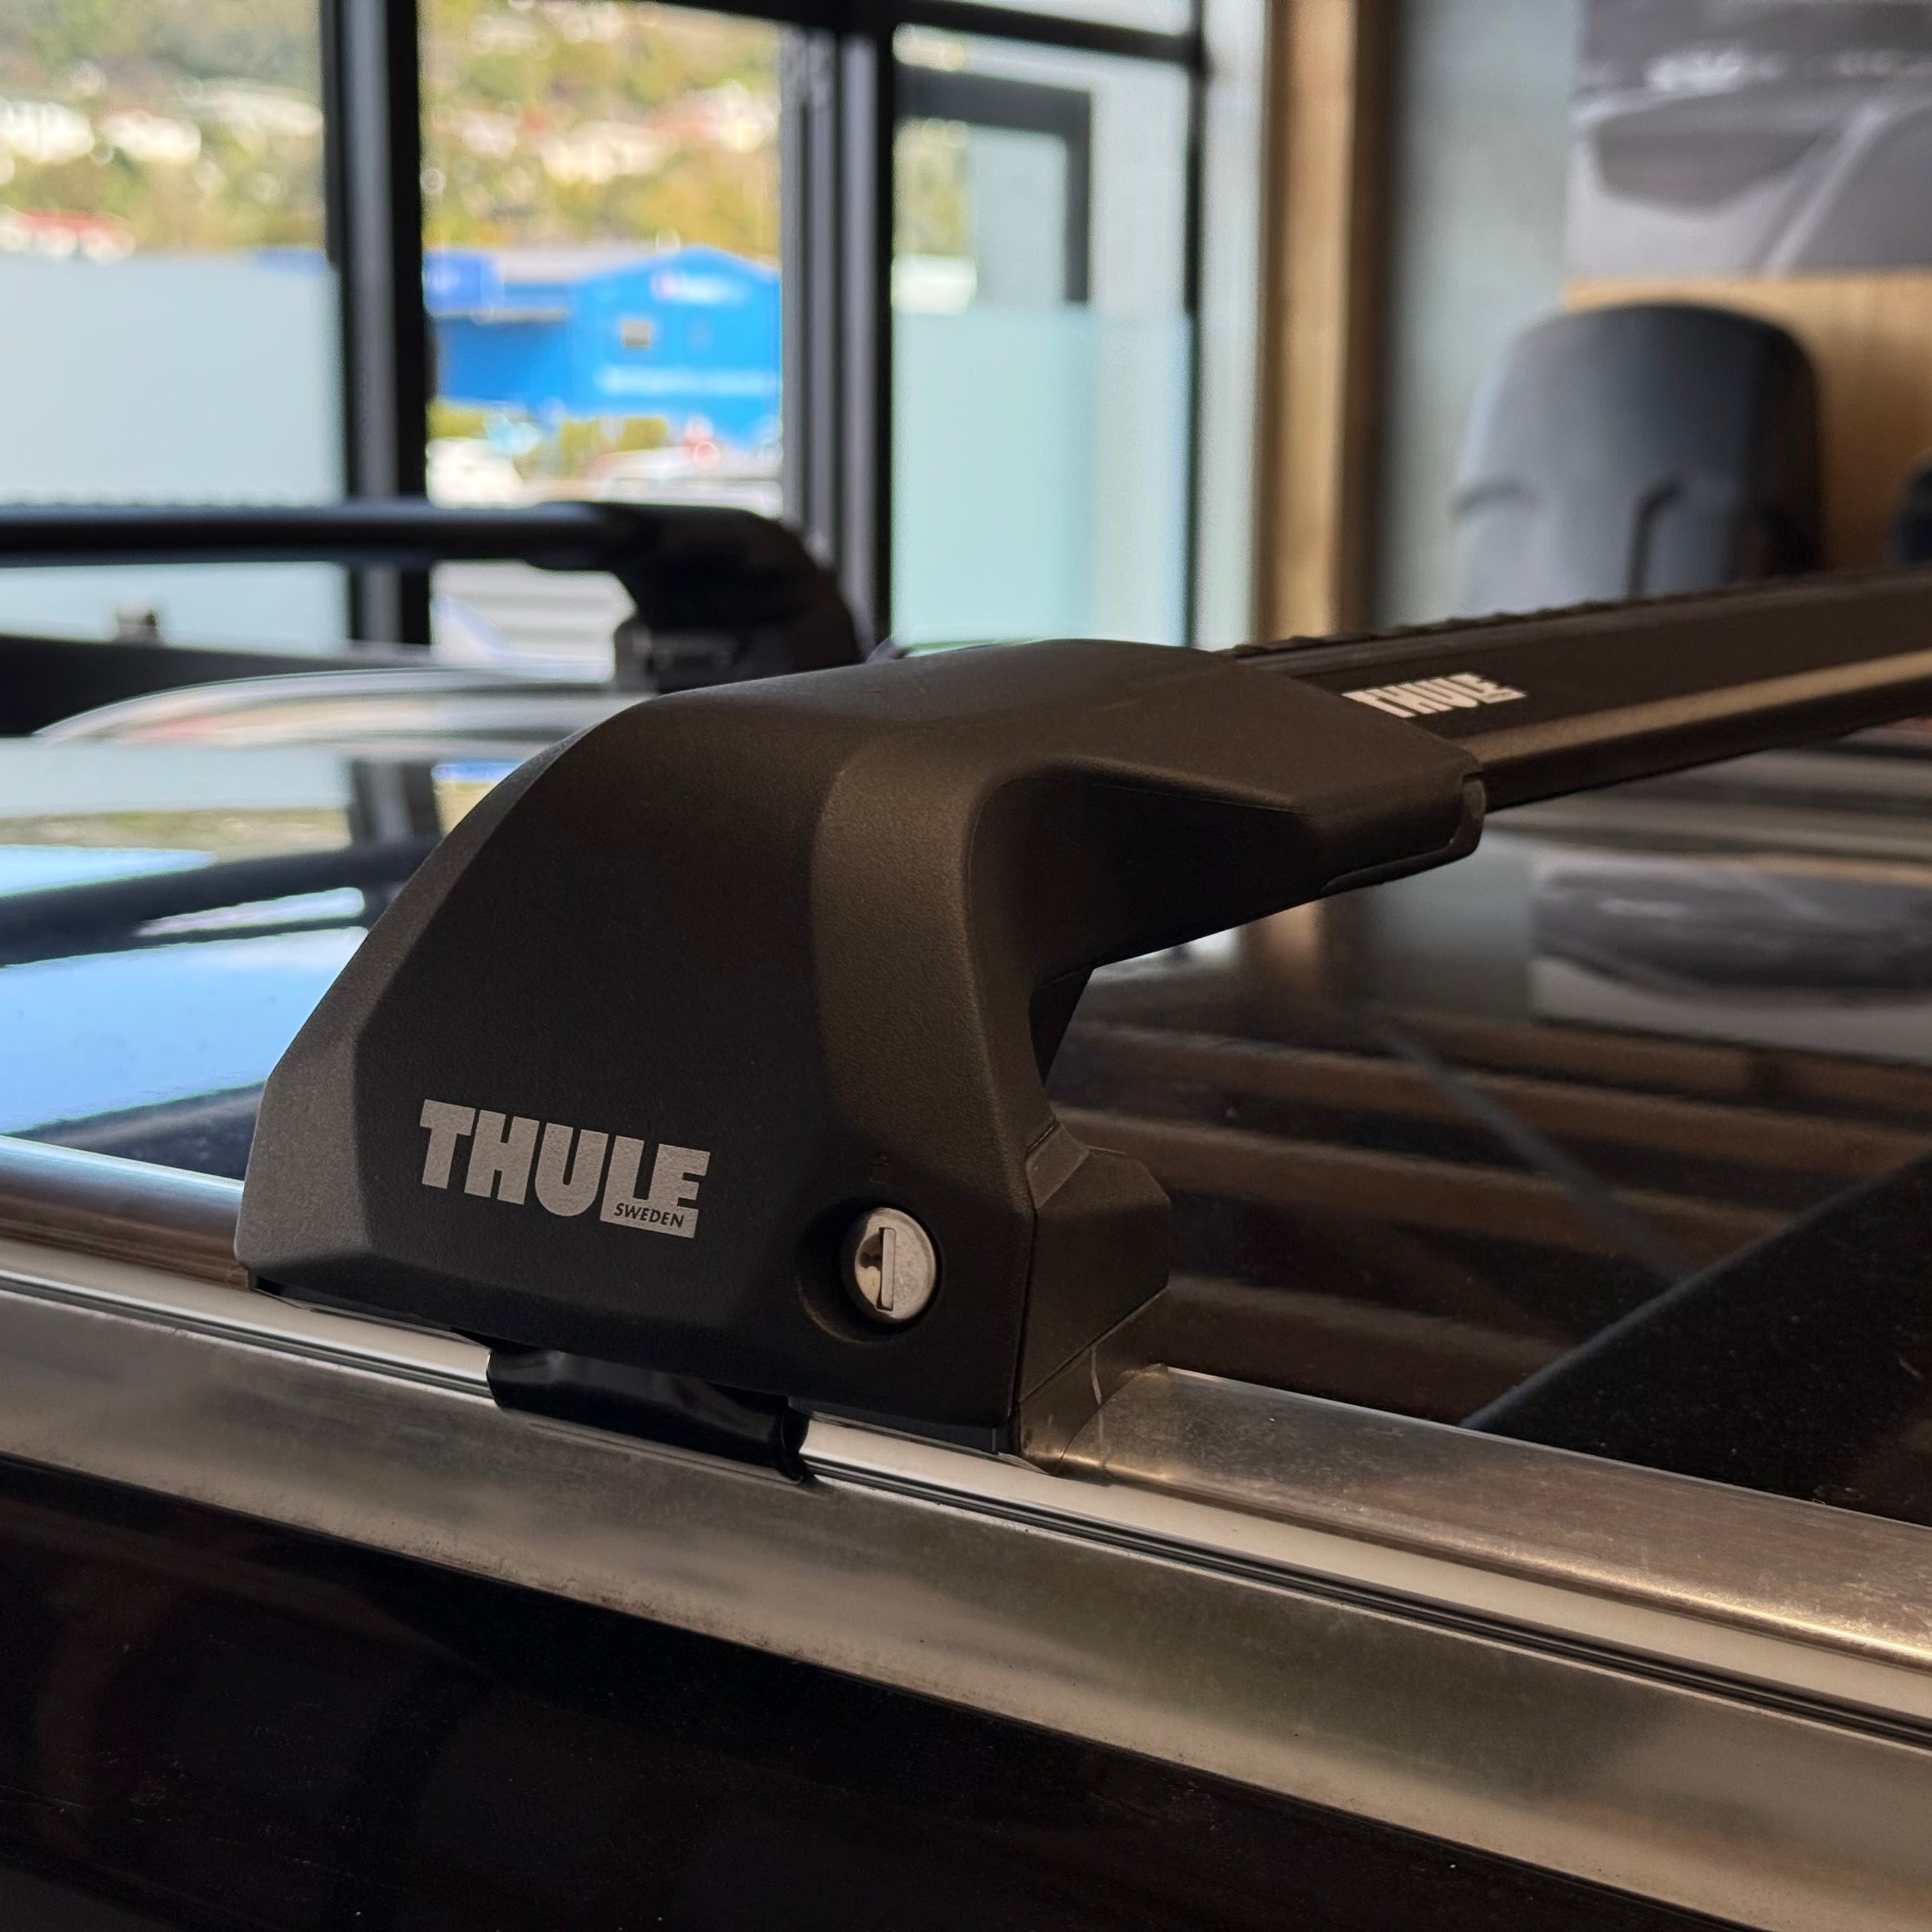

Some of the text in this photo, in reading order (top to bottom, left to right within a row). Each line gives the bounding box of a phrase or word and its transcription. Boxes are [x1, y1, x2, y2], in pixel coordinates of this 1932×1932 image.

[1341, 673, 1527, 718] THULE
[419, 1099, 710, 1238] THULE
[613, 1202, 685, 1228] SWEDEN
